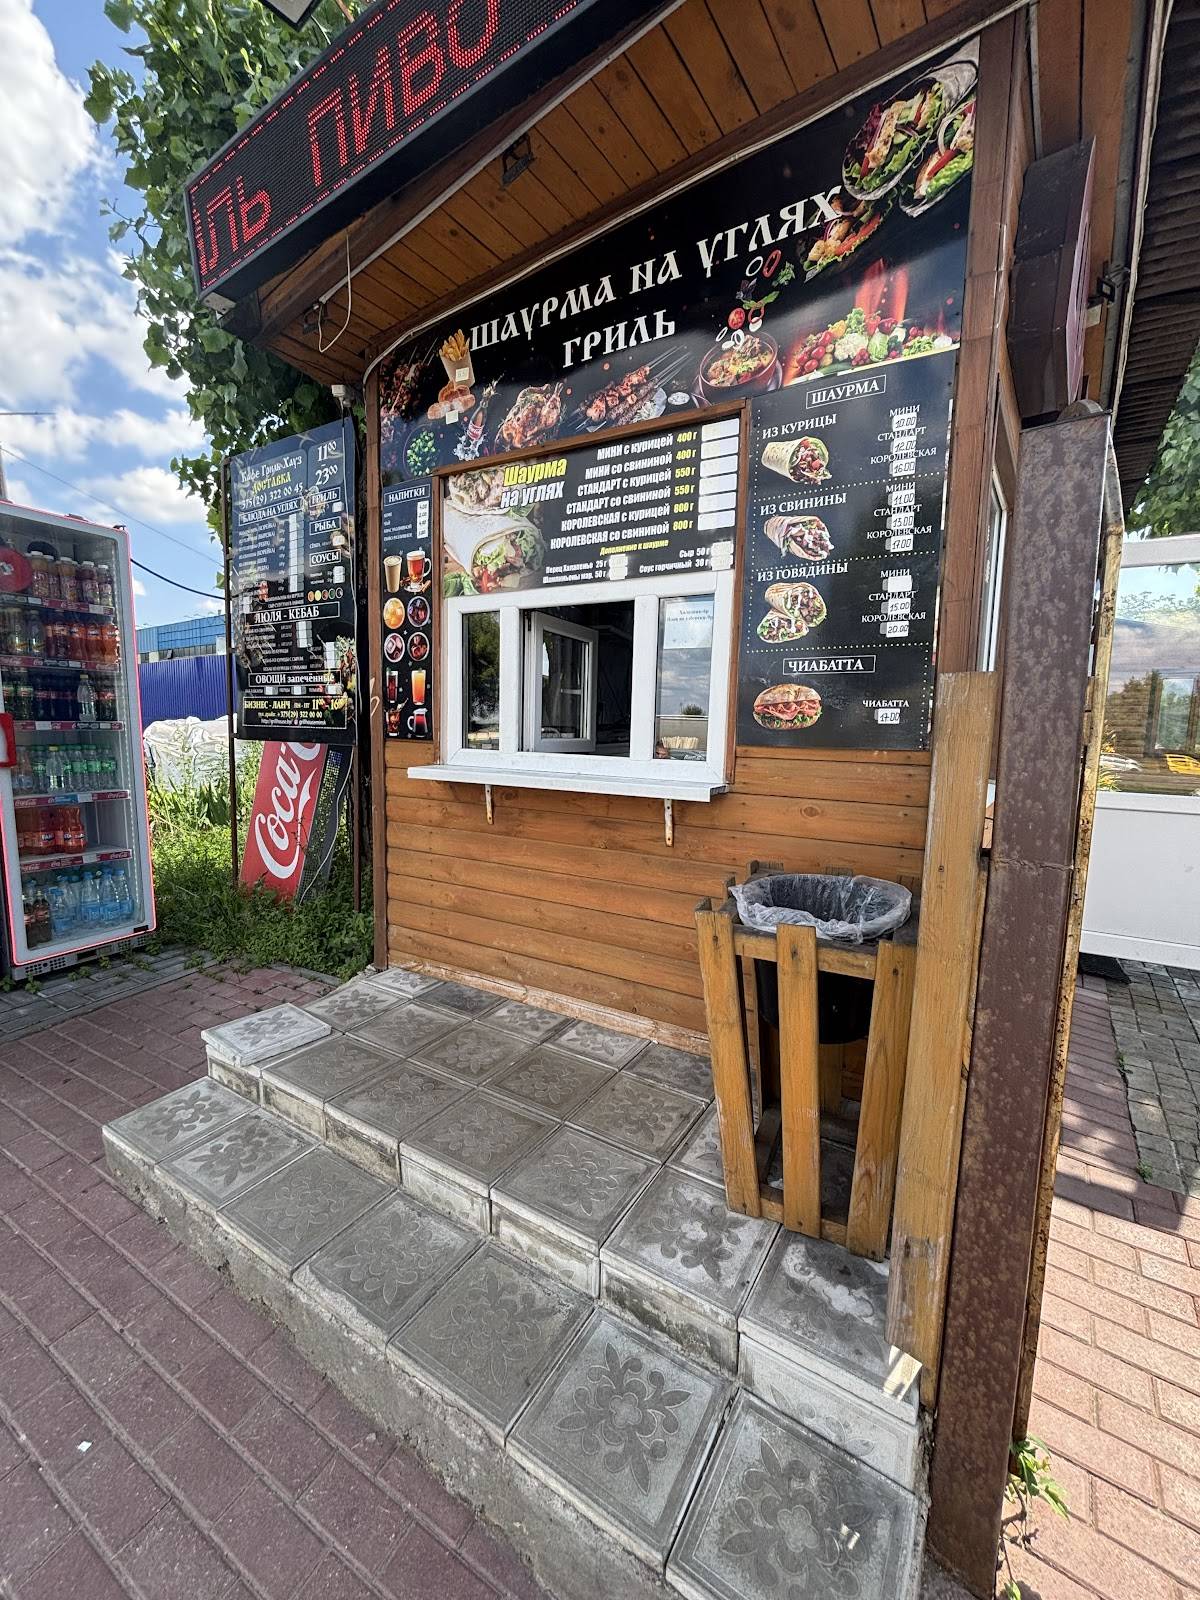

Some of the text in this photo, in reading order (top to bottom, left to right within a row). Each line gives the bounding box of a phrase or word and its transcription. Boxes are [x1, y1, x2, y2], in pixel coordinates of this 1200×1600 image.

[307, 0, 501, 187] ПИВО
[470, 185, 843, 352] ШАУРМА НА УГЛЯХ
[563, 309, 676, 369] ГРИЛЬ
[811, 379, 879, 405] ШАУРМА
[889, 404, 920, 417] МИНИ
[762, 414, 837, 440] ИЗ КУРИЦЫ
[877, 426, 927, 442] СТАНДАРТ
[597, 431, 698, 460] МИНИ с курицей 400 г
[870, 447, 937, 465] КОРОЛЕВСКАЯ
[503, 458, 567, 487] Шаурма
[585, 449, 697, 480] МИНИ со свининой 400 г
[577, 467, 696, 497] СТАНДАРТ с курицей 550 г
[886, 482, 916, 493] МИНИ
[269, 489, 281, 501] 322
[283, 486, 292, 496] 00
[294, 482, 304, 494] 45
[312, 491, 338, 505] ГРИЛЬ
[389, 487, 426, 503] НАПИТКИ
[500, 481, 565, 509] на углях
[566, 484, 695, 515] СТАНДАРТ со свининой 550 г
[266, 506, 277, 517] НА
[277, 500, 299, 513] УГЛЯХ
[760, 493, 847, 516] ИЗ СВИНИНЫ
[873, 504, 922, 518] СТАНДАРТ
[561, 502, 694, 531] КОРОЛЕВСКАЯ с курицей 800 г
[314, 520, 337, 532] РЫБА
[866, 525, 932, 539] КОРОЛЕВСКАЯ
[550, 520, 694, 549] КОРОЛЕВСКАЯ со свининой 800 г
[311, 551, 339, 565] СОУСЫ
[696, 547, 706, 556] 50
[595, 560, 604, 568] 25
[757, 562, 849, 582] ИЗ ГОВЯДИНЫ
[594, 570, 603, 579] 50
[881, 568, 910, 578] МИНИ
[868, 591, 917, 602] СТАНДАРТ
[254, 610, 282, 624] ЛЮЛЯ
[288, 605, 320, 619] КЕБАБ
[861, 612, 926, 623] КОРОЛЕВСКАЯ
[788, 659, 863, 672] ЧИАБАТТА
[255, 673, 286, 685] ОВОЩИ
[244, 700, 269, 709] БИЗНЕС
[272, 700, 290, 709] ЛАНЧ
[862, 700, 910, 708] ЧИАБАТТА
